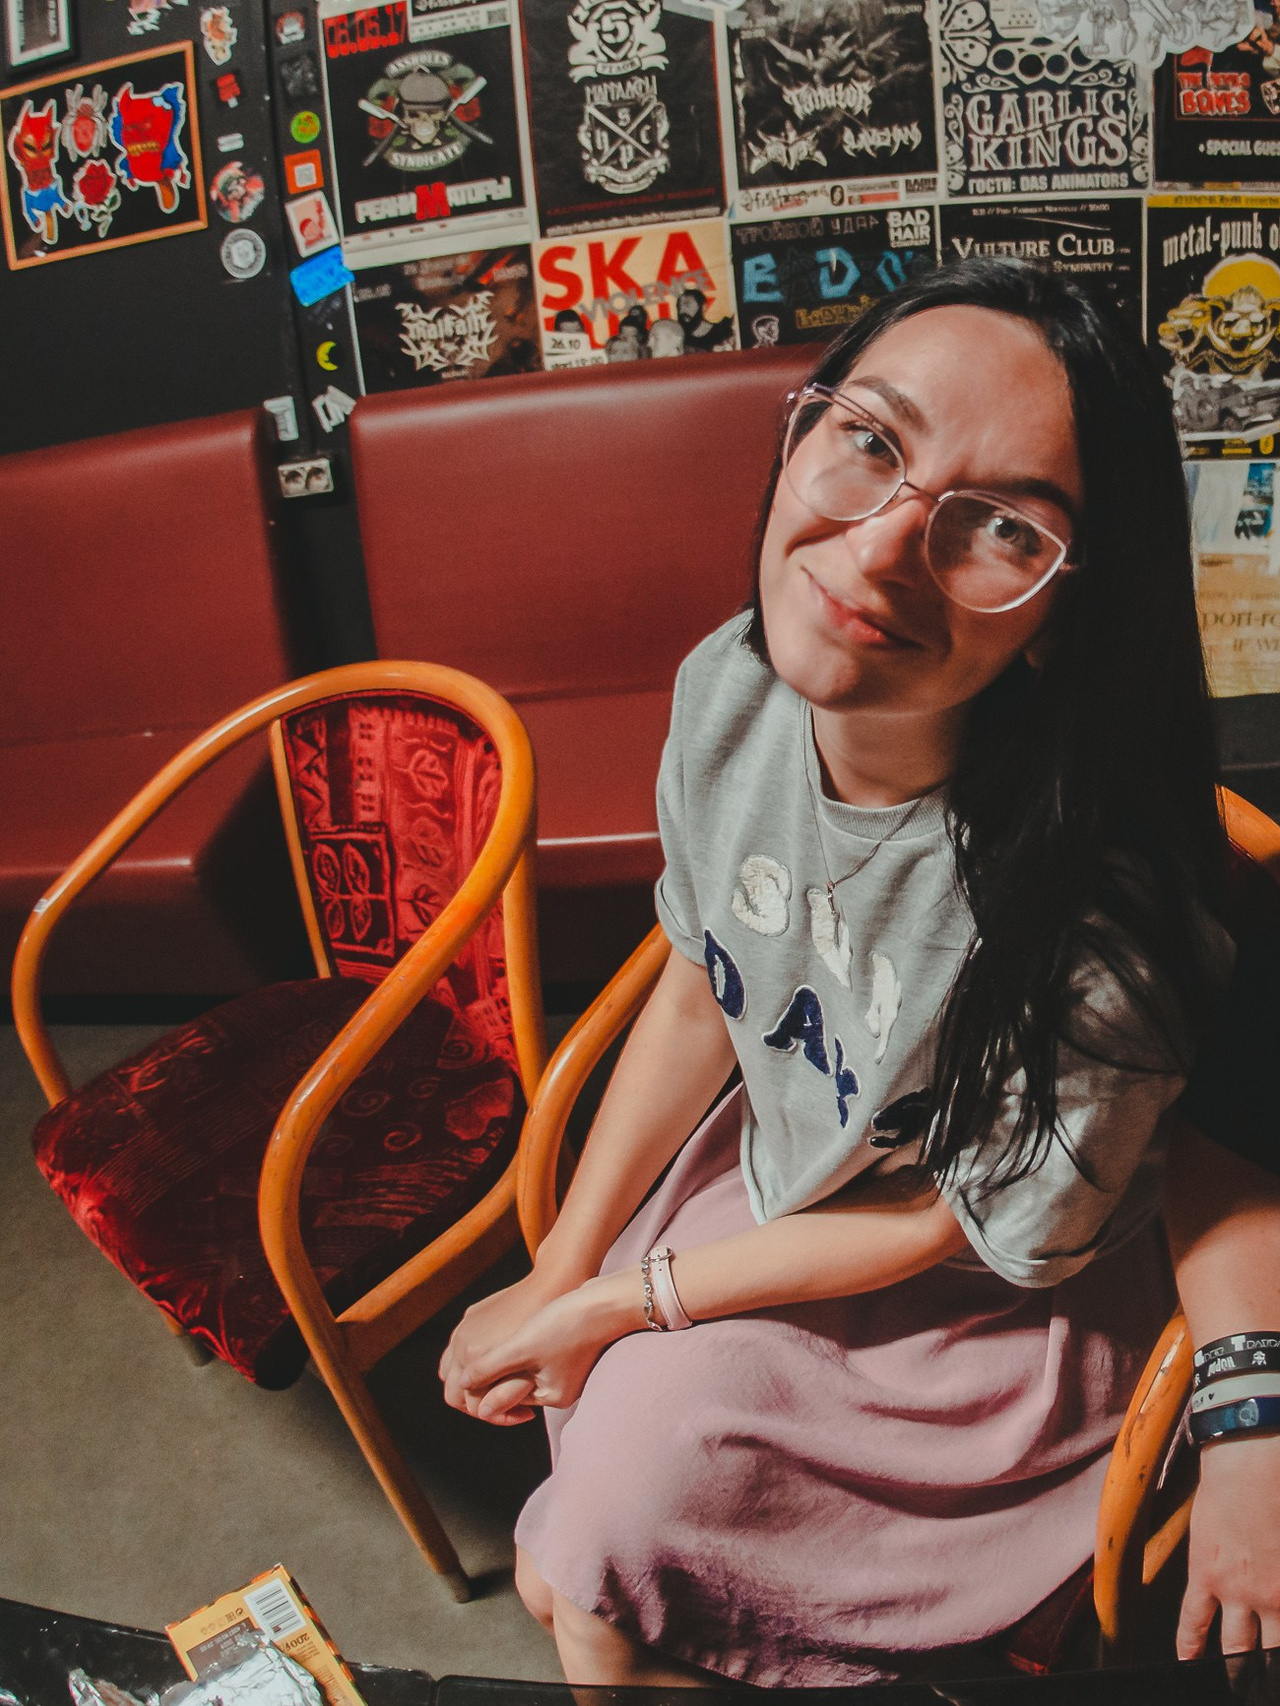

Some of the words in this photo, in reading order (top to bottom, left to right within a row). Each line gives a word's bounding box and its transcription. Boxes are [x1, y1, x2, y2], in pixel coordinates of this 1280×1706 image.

[965, 89, 1127, 137] GARLIC
[1180, 88, 1252, 115] BONES
[968, 117, 1129, 172] KINGS
[1205, 139, 1252, 156] SPECIAL
[968, 177, 1017, 195] ГОСТИ:
[1019, 174, 1048, 192] DAS
[1051, 172, 1129, 190] ANIMATORS
[887, 209, 931, 227] BAD
[889, 225, 931, 242] HAIR
[1056, 233, 1115, 257] CLUB
[1162, 211, 1263, 268] metal-punk
[538, 231, 717, 312] SKA
